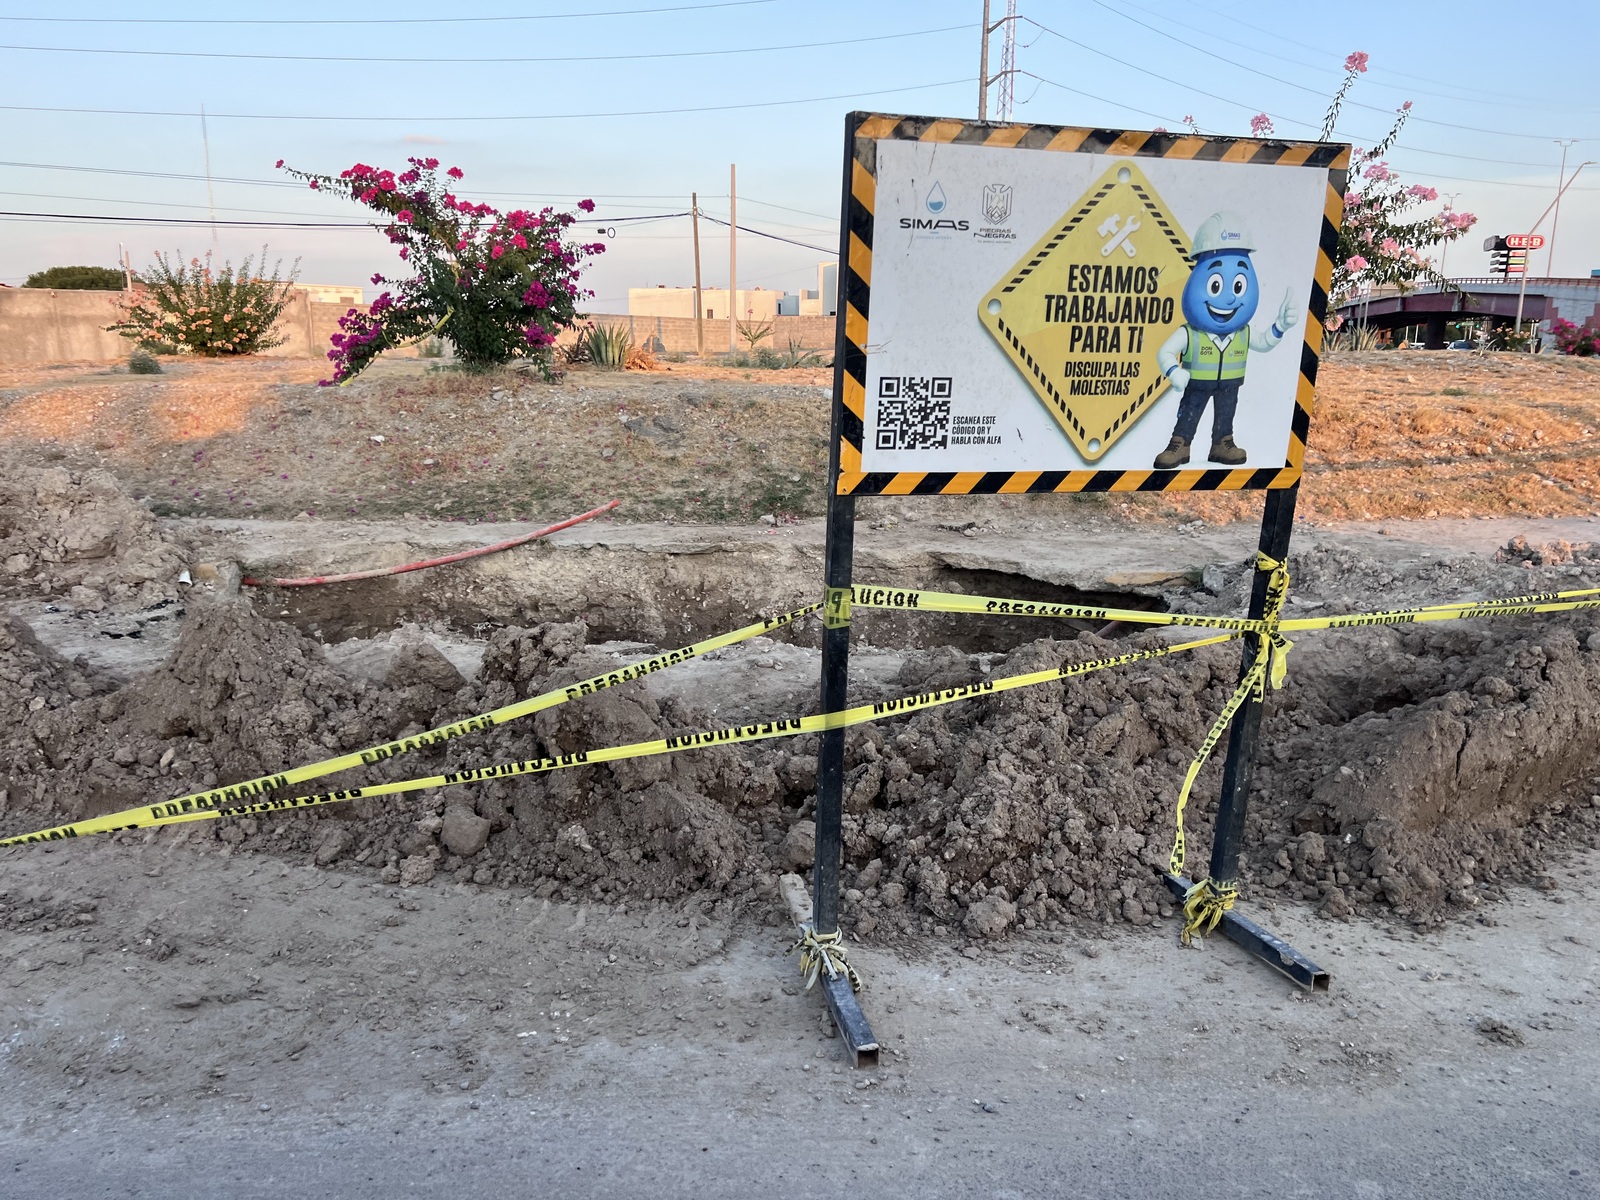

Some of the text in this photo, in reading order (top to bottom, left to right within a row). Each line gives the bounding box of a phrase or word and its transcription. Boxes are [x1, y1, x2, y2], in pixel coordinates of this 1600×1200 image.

[900, 218, 969, 231] SIMAS
[1067, 264, 1159, 295] ESTAMOS
[1044, 294, 1175, 325] TRABAJANDO
[1069, 325, 1144, 353] PARA TI
[1064, 361, 1140, 378] DISCULPA LAS
[1069, 379, 1131, 396] MOLESTIAS
[952, 415, 997, 425] ESCANEA ESTE
[951, 425, 992, 435] CÓDIGO QR Y
[951, 436, 1002, 445] HABLA CON ALFA
